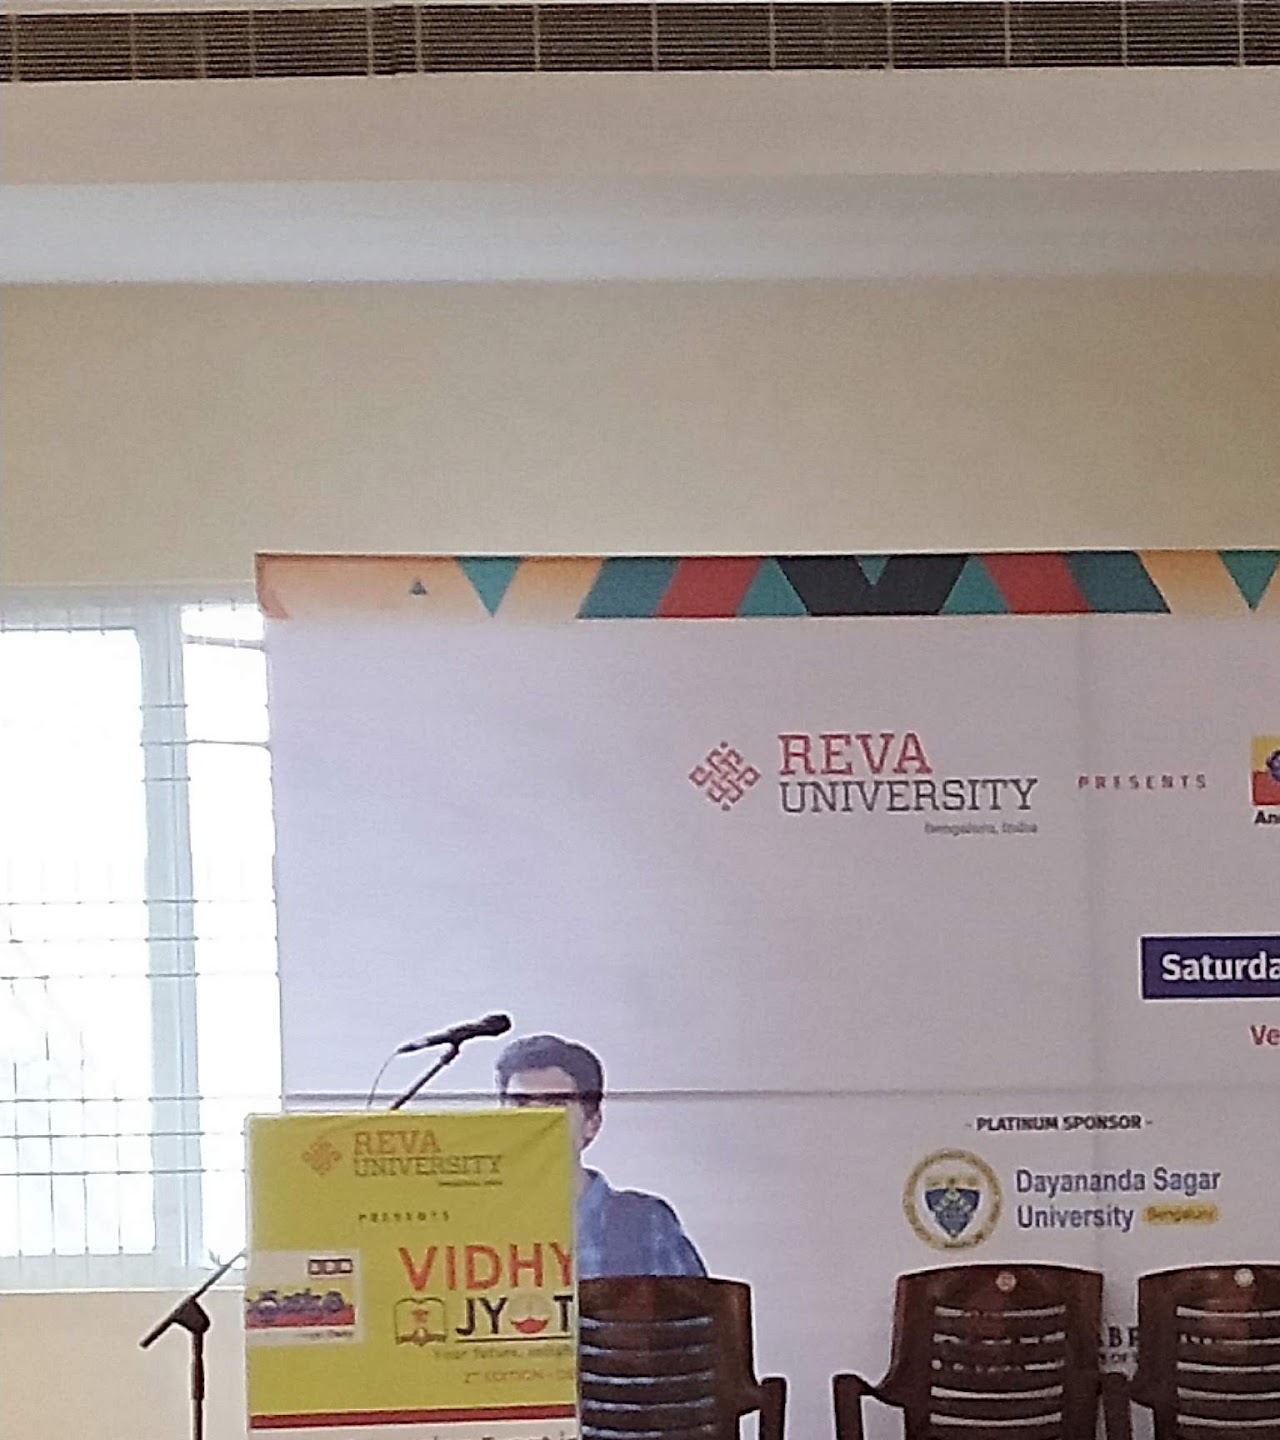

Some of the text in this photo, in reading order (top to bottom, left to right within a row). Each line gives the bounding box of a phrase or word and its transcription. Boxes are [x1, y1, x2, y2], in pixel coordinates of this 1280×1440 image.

[778, 732, 934, 776] REVA
[779, 777, 1039, 814] UNIVERSITY
[1077, 774, 1208, 790] PRESENTS
[976, 1114, 1142, 1131] PLATINUM SPONSOR
[353, 1129, 443, 1156] REVA
[353, 1154, 504, 1178] UNIVERSITY
[1015, 1166, 1222, 1199] Dayananda Sagar
[1017, 1203, 1135, 1233] University
[398, 1241, 574, 1293] VIDHY
[454, 1294, 574, 1336] JYOT
